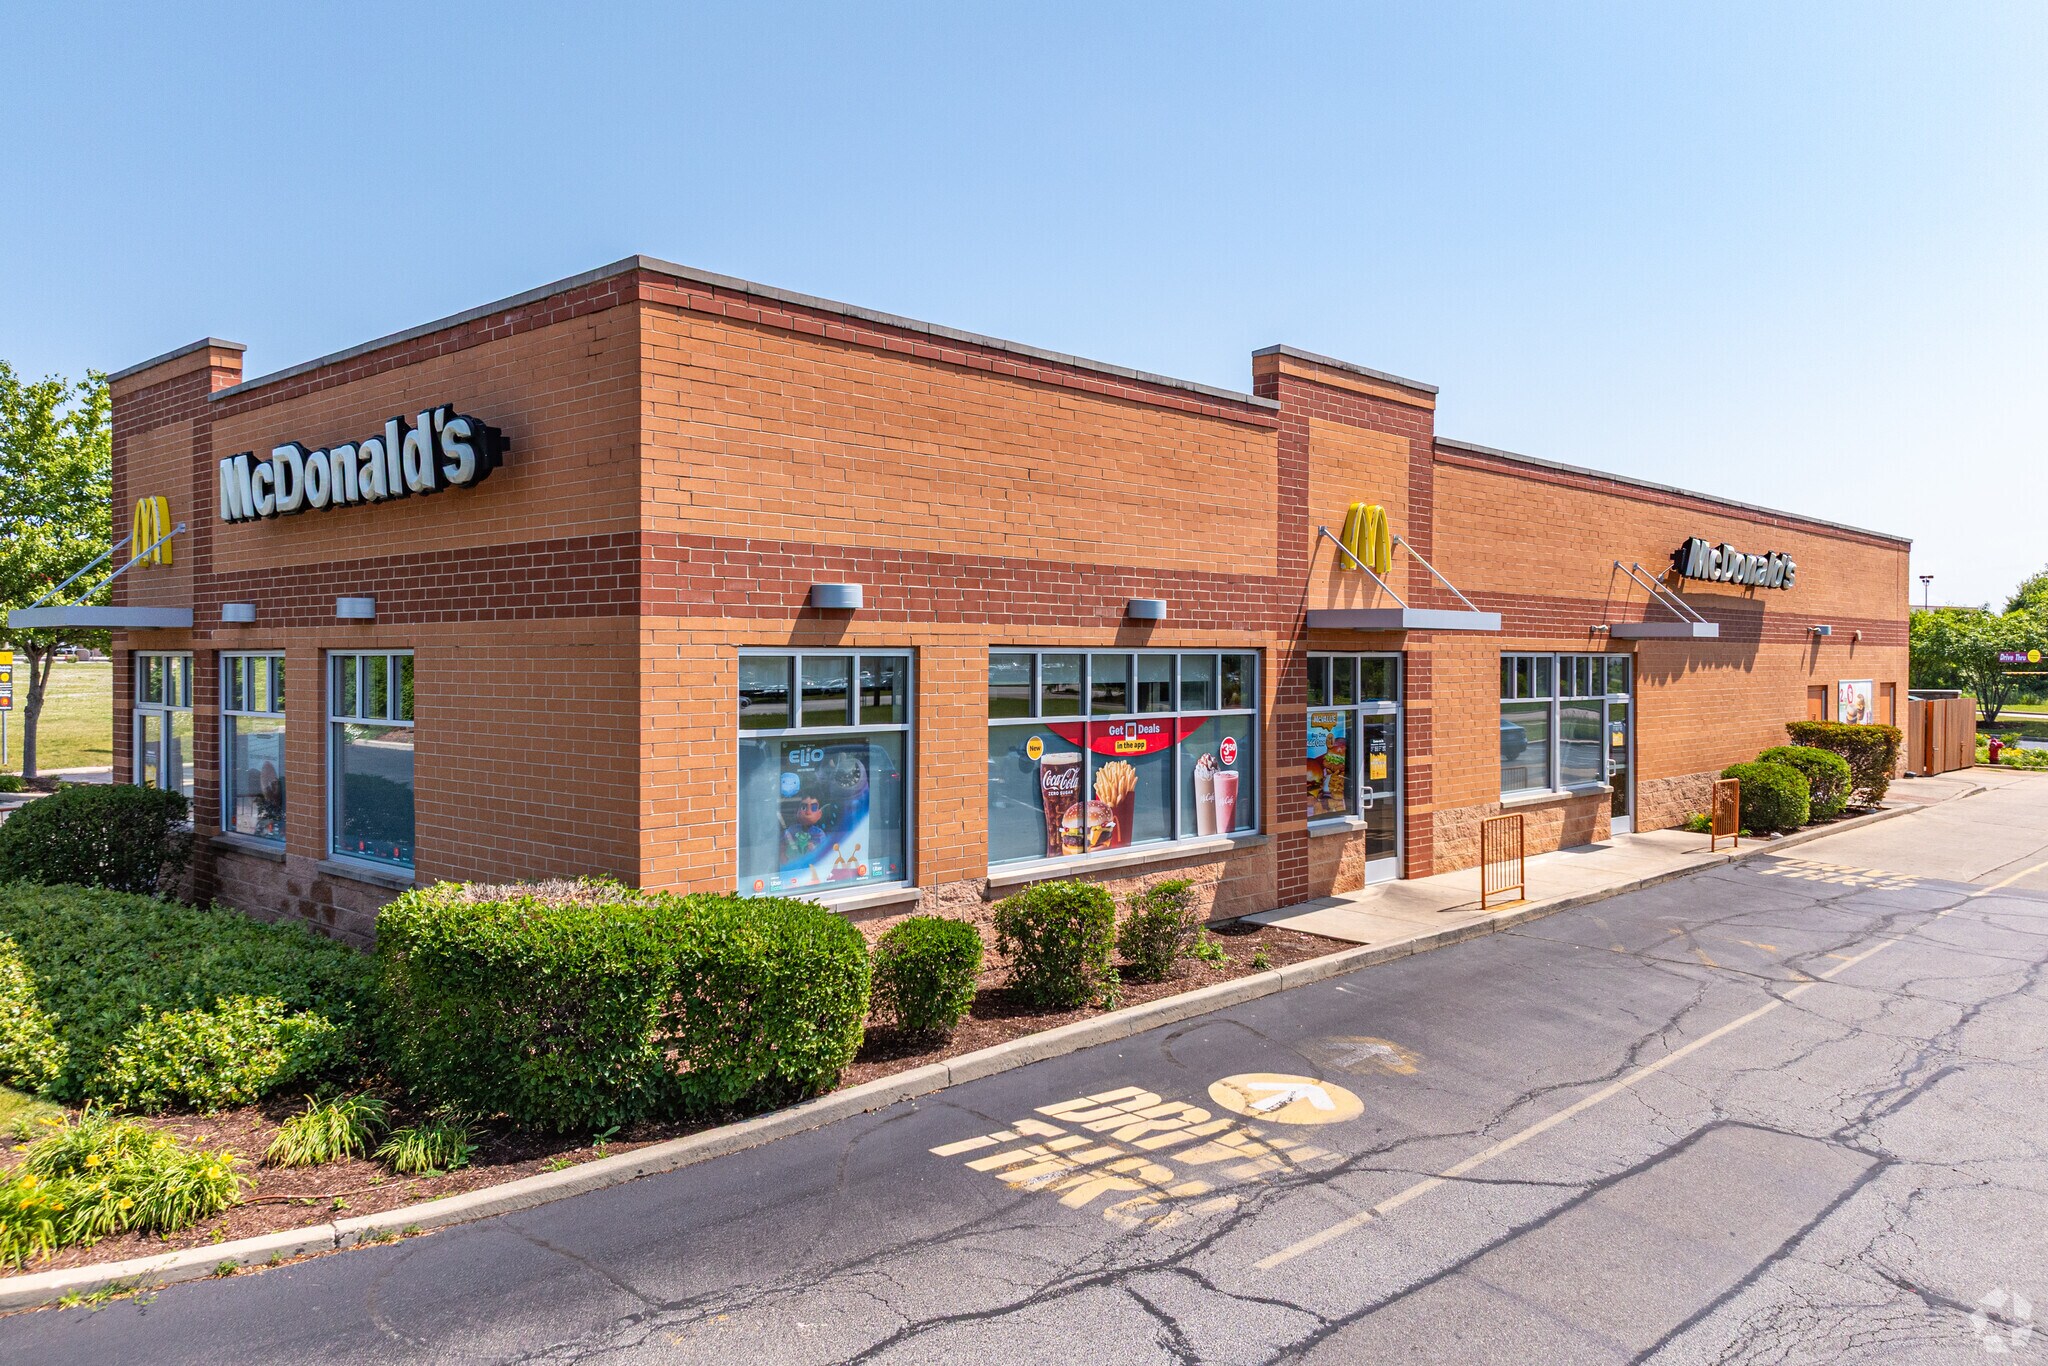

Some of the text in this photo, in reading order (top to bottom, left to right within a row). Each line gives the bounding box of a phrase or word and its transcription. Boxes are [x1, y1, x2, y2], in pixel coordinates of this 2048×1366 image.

[219, 407, 477, 521] McDonald's
[1685, 538, 1797, 589] McDonald's
[2000, 653, 2014, 661] Drive
[2015, 653, 2027, 661] Thru
[1109, 724, 1160, 736] Get Deals
[1124, 741, 1133, 749] the
[1134, 741, 1145, 750] app
[1042, 767, 1080, 790] Coca-Cola
